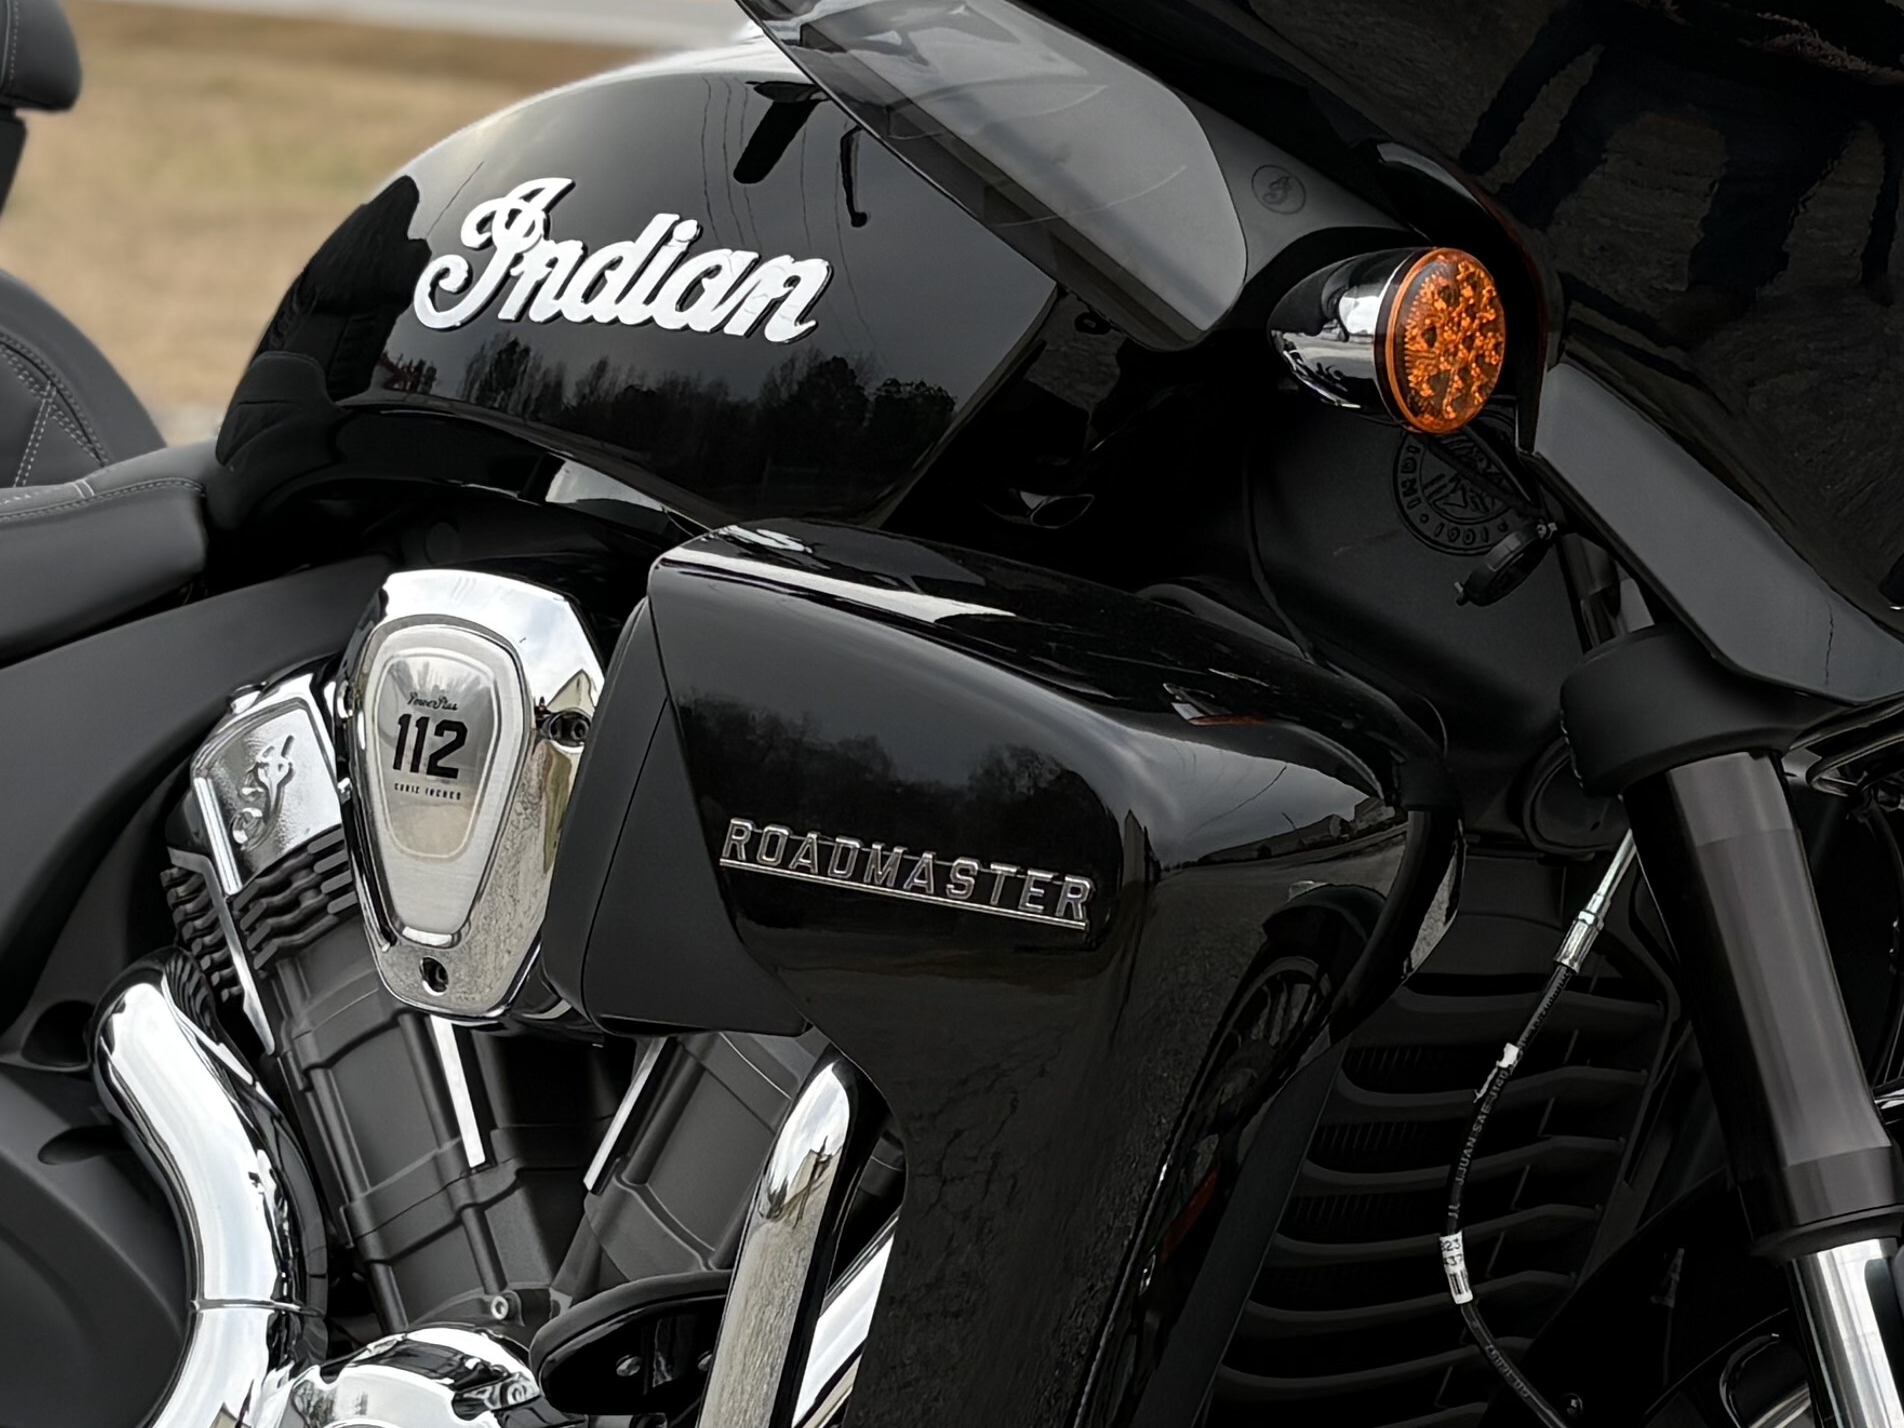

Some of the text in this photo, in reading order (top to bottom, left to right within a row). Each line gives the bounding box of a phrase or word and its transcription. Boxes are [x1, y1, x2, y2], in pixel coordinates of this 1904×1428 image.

[413, 177, 834, 343] Indian
[392, 713, 468, 779] 112
[721, 818, 1095, 921] ROADMASTER
